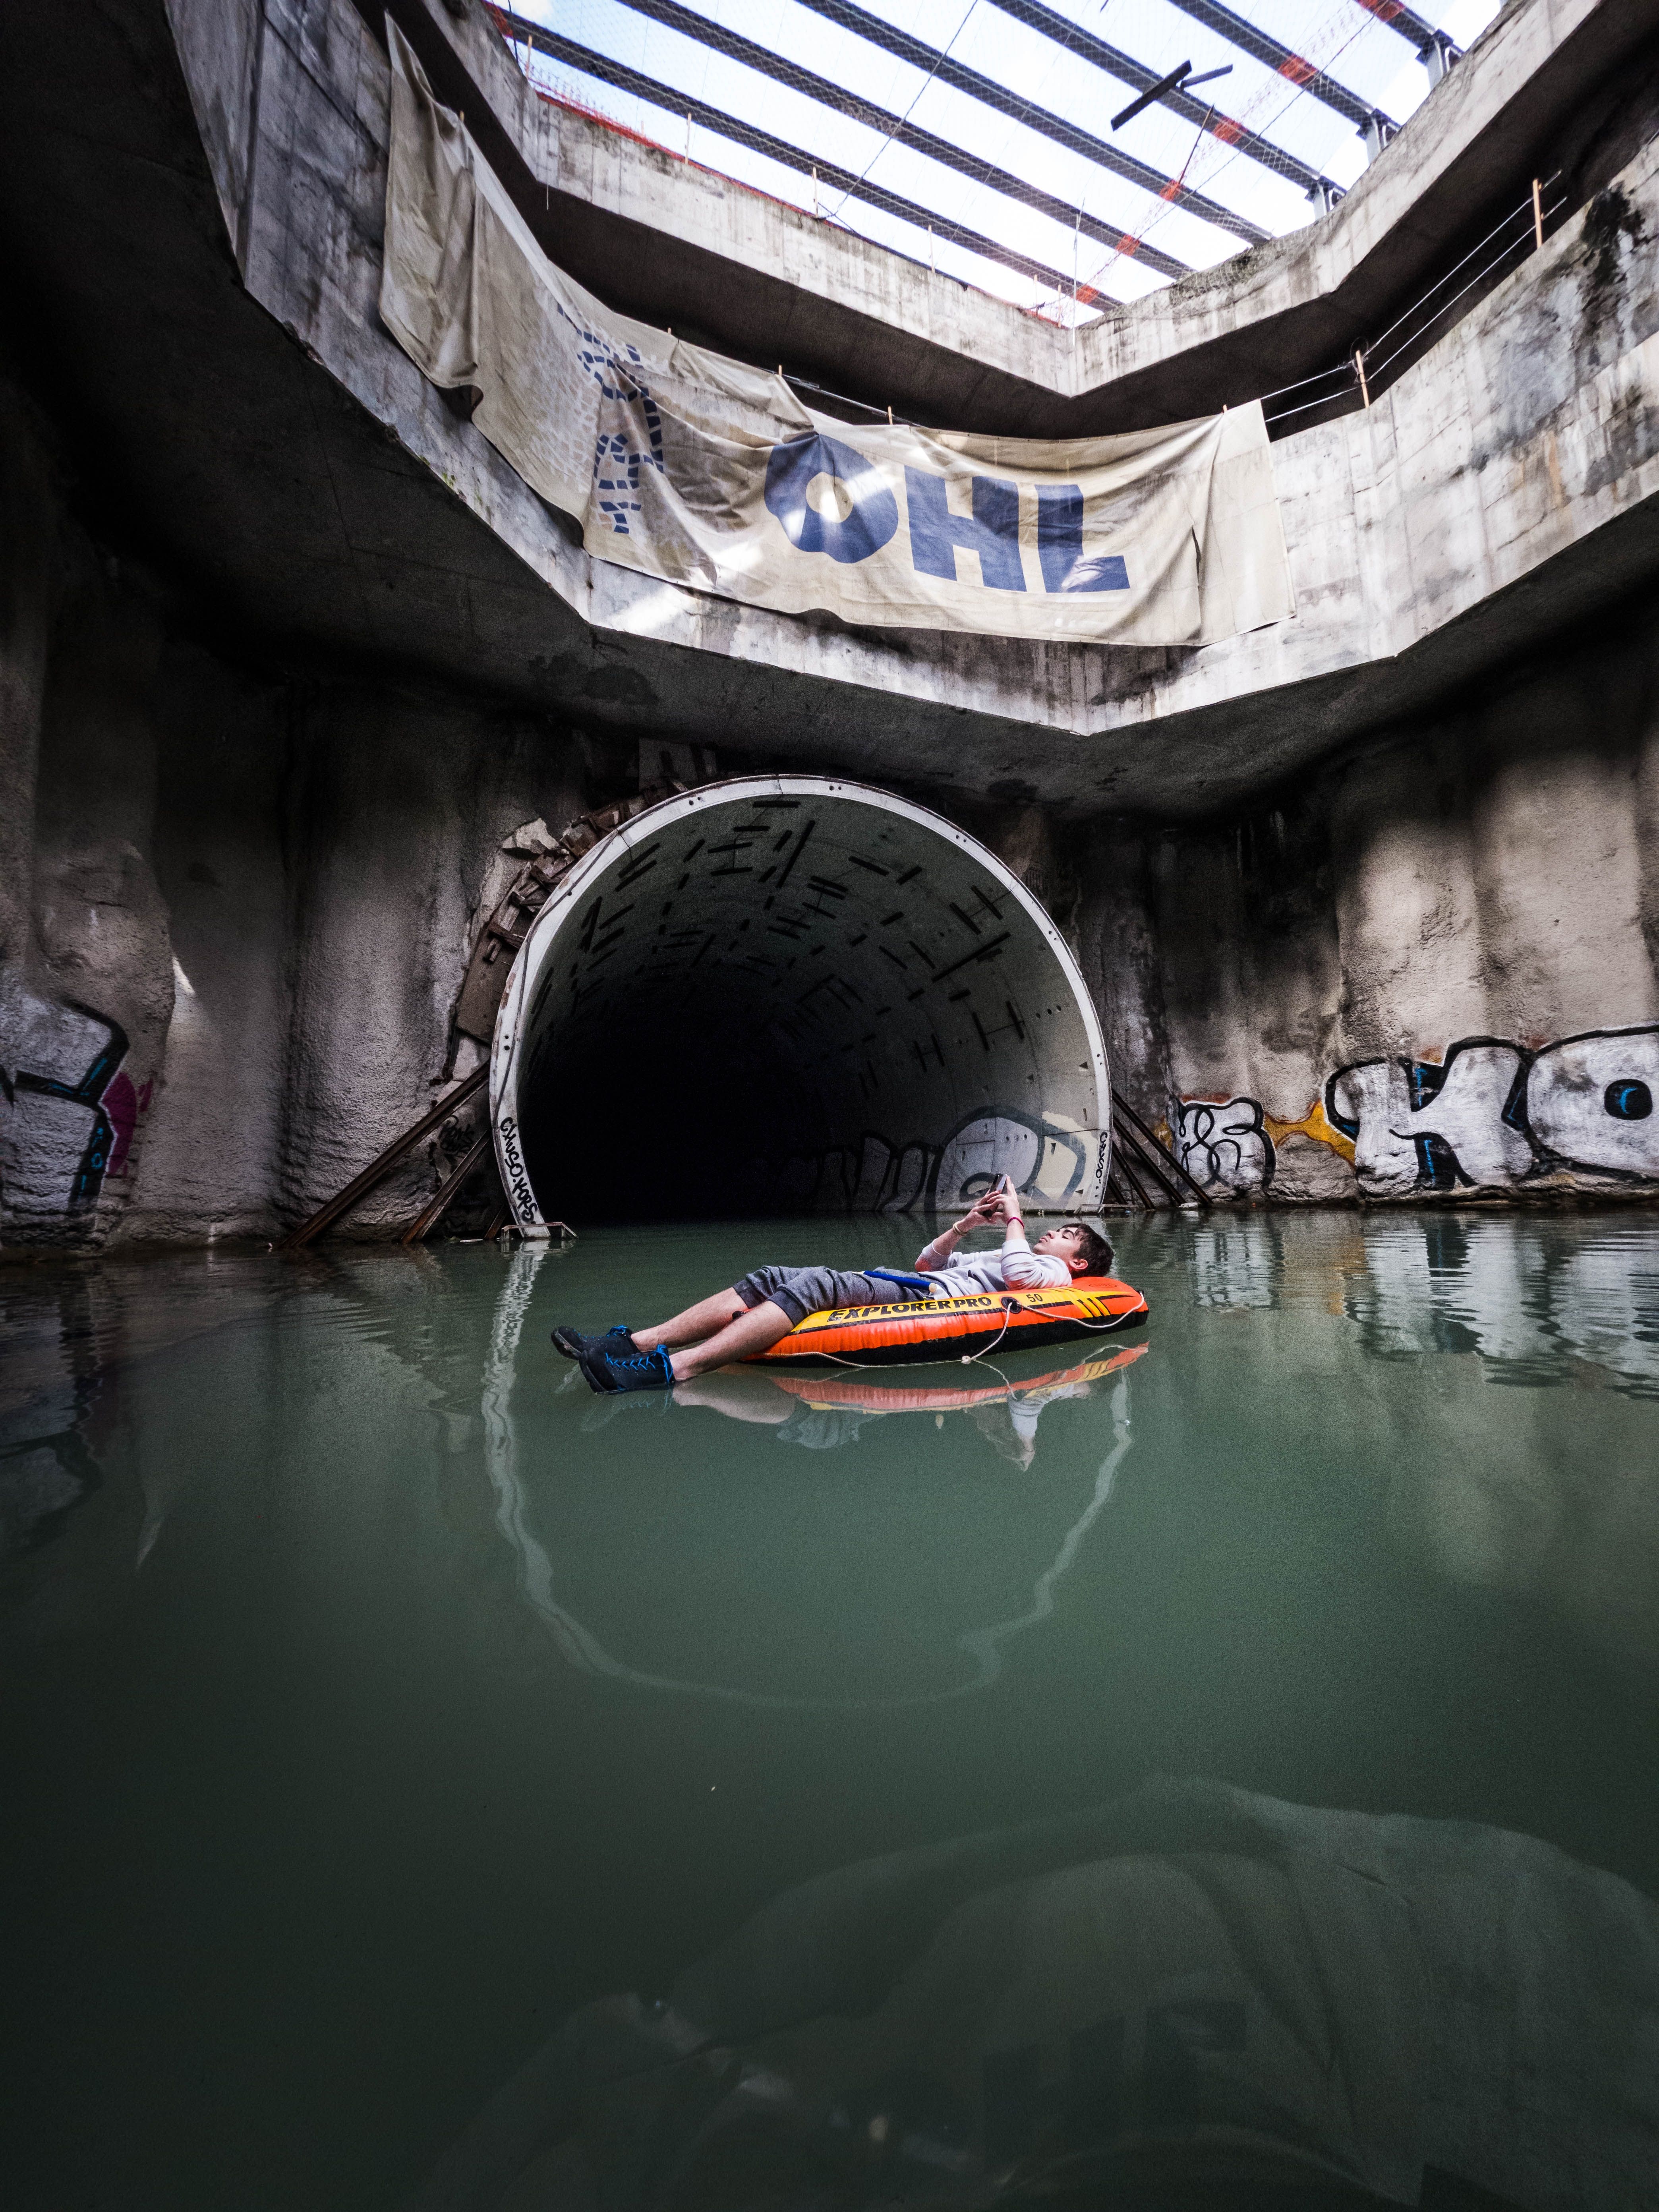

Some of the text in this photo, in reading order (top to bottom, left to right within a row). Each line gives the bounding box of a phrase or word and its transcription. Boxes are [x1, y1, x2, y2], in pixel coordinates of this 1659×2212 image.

[764, 433, 1130, 593] OHL
[827, 1294, 1043, 1322] EXPLORER PRO 50
